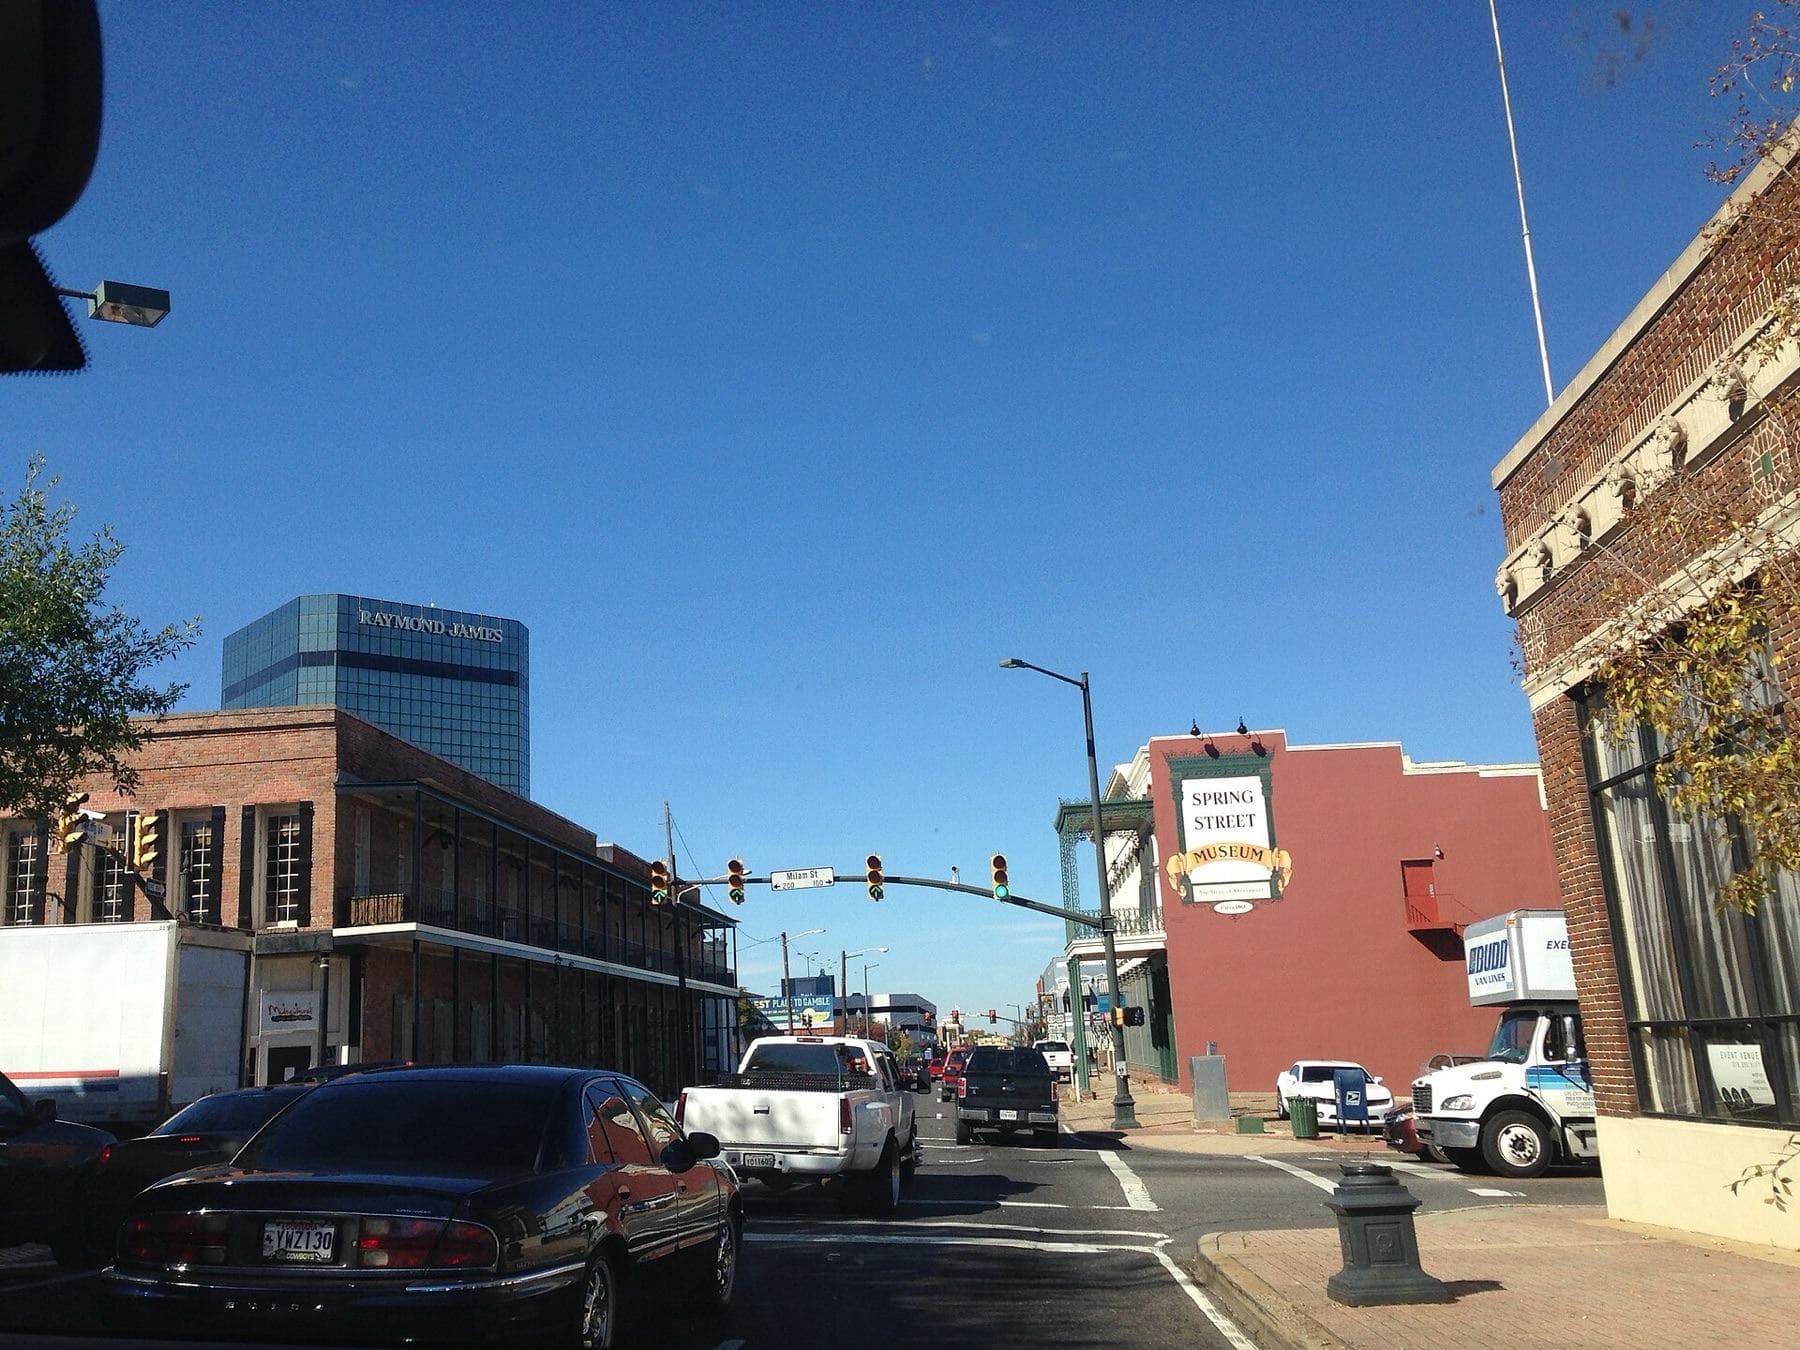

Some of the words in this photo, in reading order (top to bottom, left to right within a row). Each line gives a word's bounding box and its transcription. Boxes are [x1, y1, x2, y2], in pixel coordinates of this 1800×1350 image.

[359, 609, 445, 634] RAYMOND
[449, 623, 503, 642] JAMES
[1192, 790, 1254, 806] SPRING
[1194, 813, 1256, 830] STREET
[1193, 845, 1264, 863] MUSEUM
[786, 872, 808, 880] Milam
[1546, 940, 1569, 949] EXE
[1476, 939, 1508, 973] BUDD
[1474, 975, 1488, 986] VAN
[1488, 972, 1506, 983] LINES
[753, 999, 771, 1009] EST
[794, 998, 802, 1007] TO
[804, 997, 830, 1006] GAMBLE
[1720, 1050, 1738, 1060] EVENT
[1740, 1051, 1760, 1060] VENUE
[286, 1252, 315, 1260] COWBOYS
